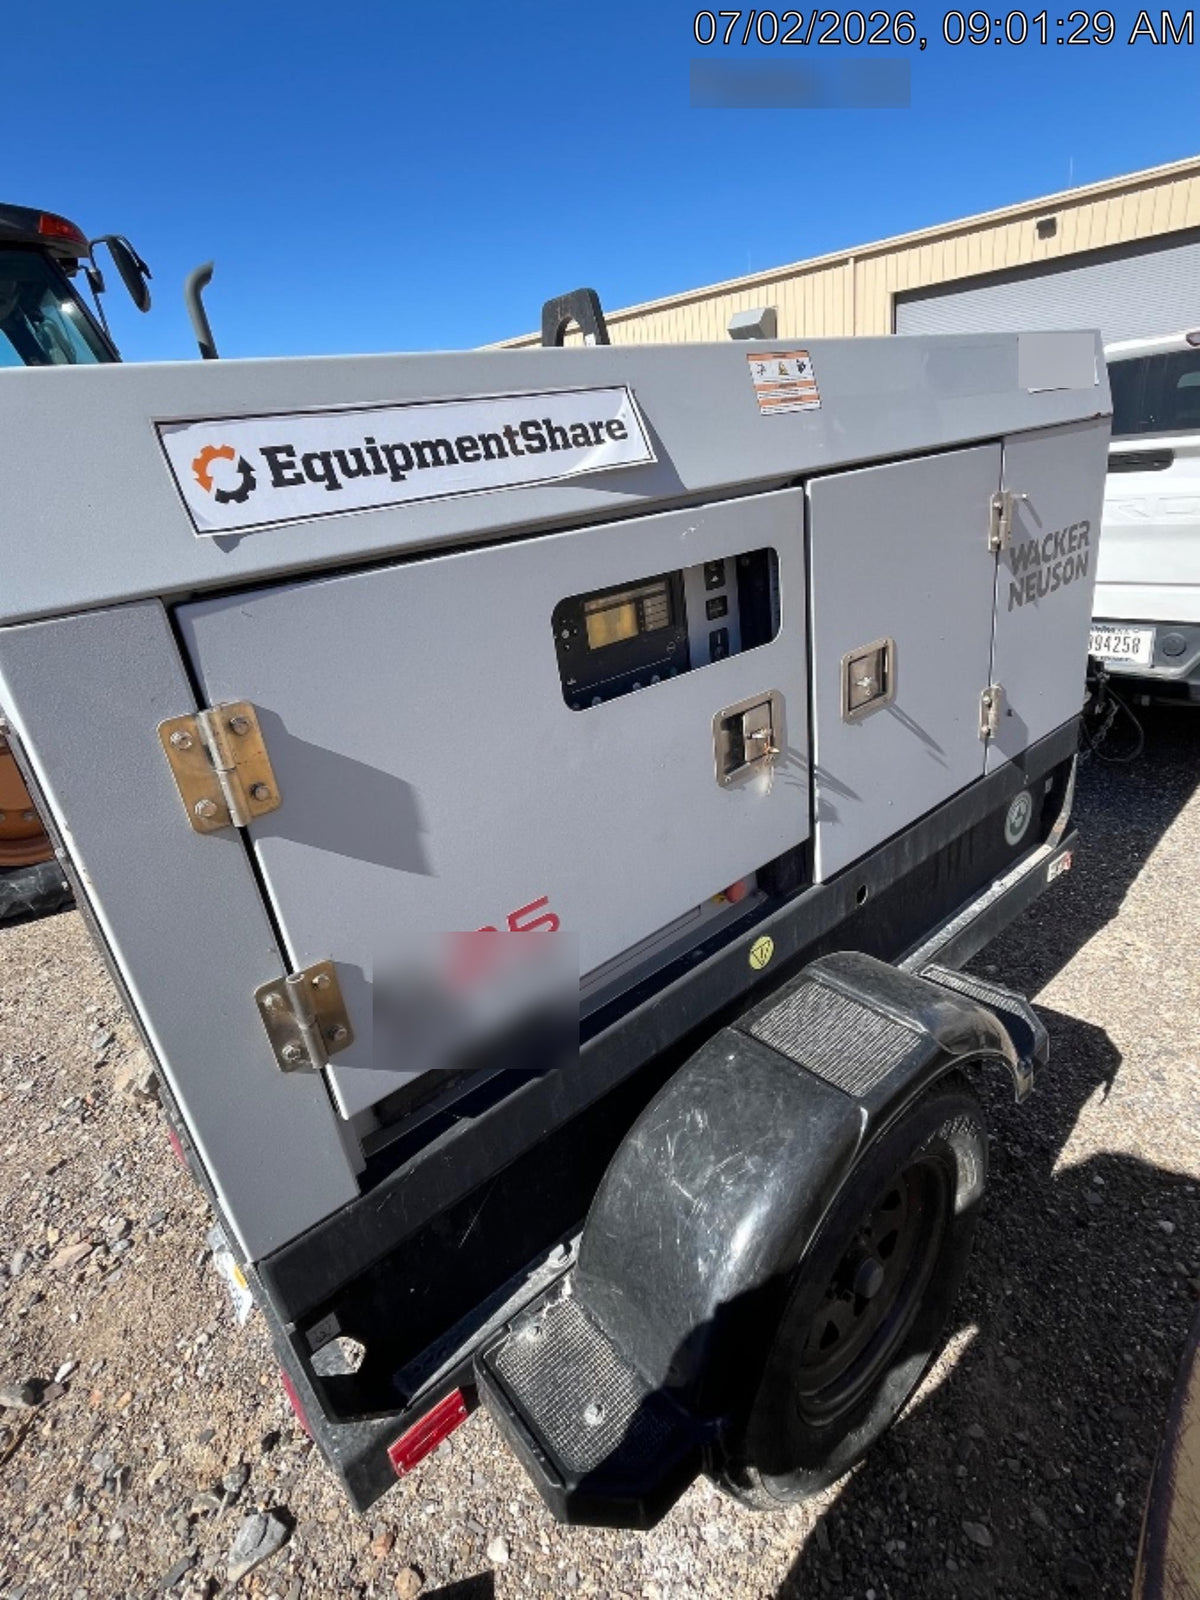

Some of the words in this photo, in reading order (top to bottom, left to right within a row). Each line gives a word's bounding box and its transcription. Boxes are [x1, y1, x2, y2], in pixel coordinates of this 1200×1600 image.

[259, 417, 629, 491] EquipmentShare
[1010, 520, 1090, 576] WACKER
[1007, 549, 1089, 612] NEUSON
